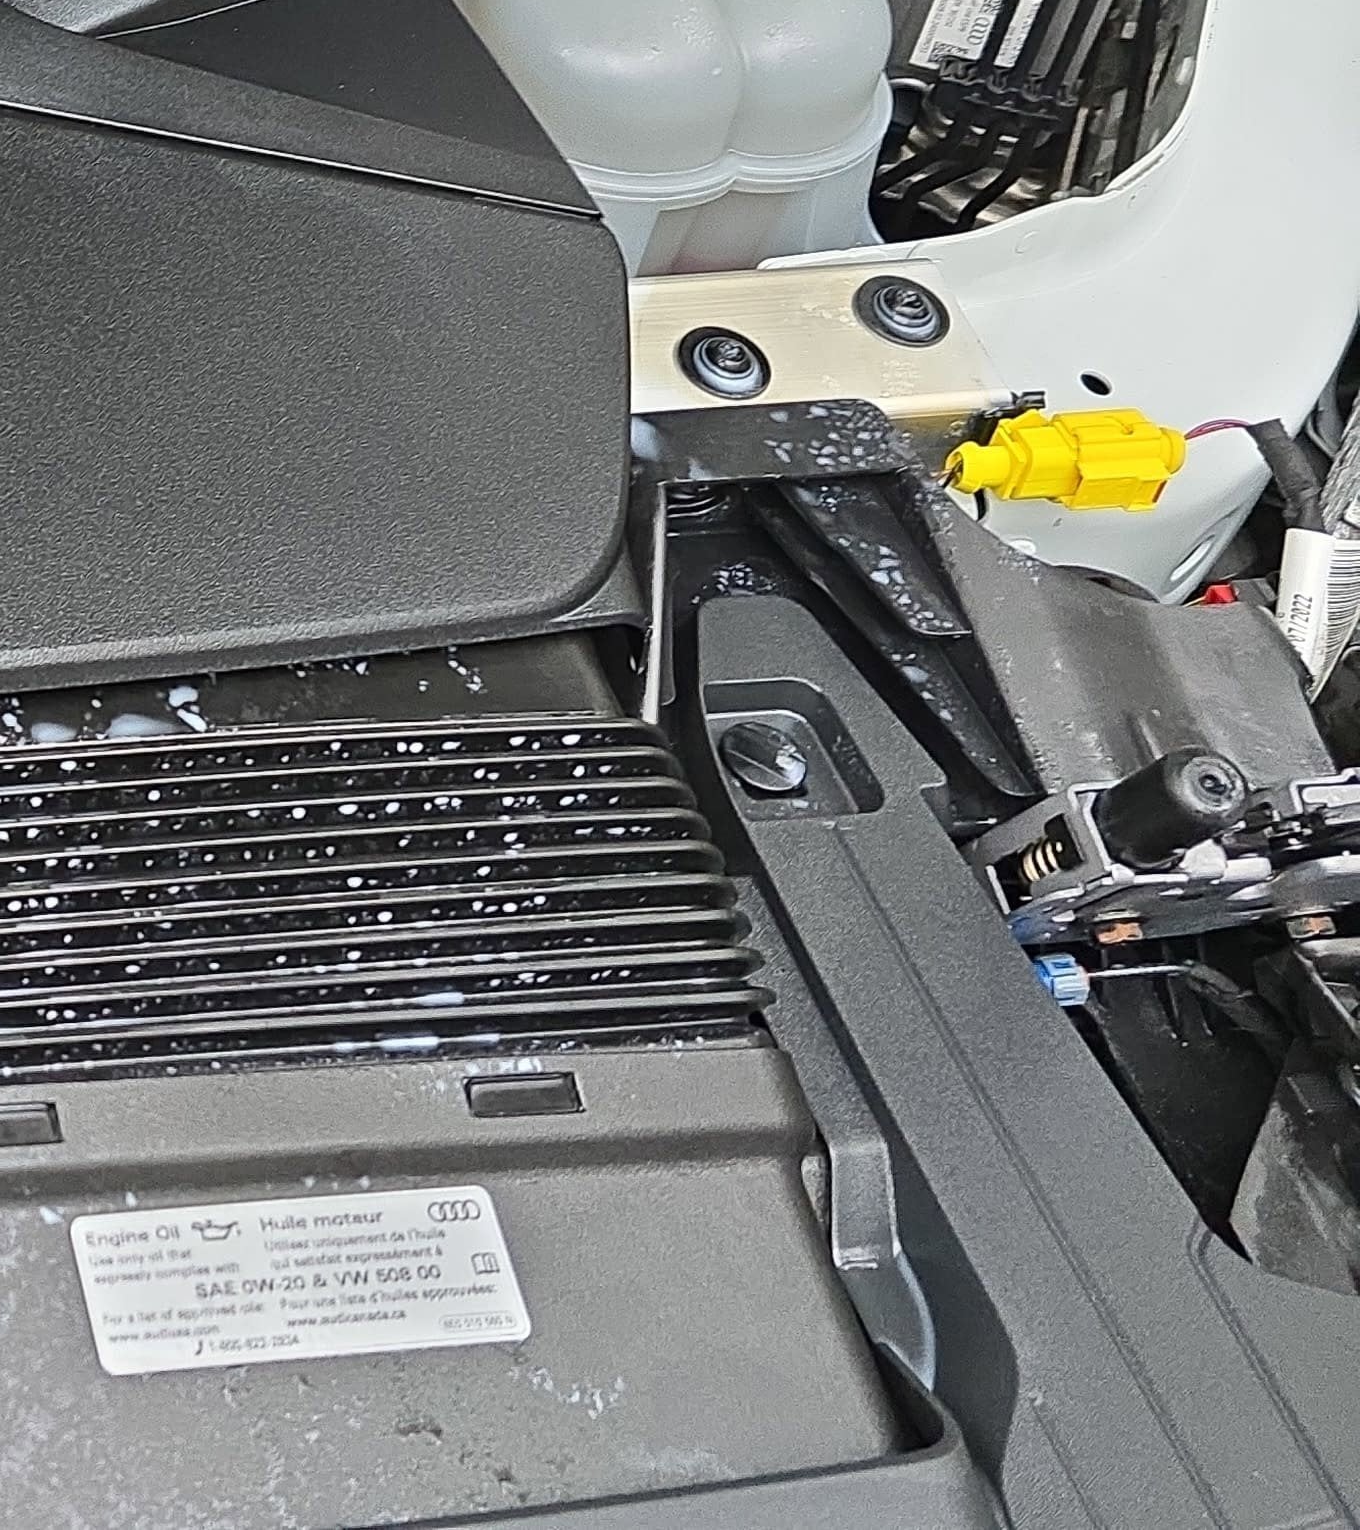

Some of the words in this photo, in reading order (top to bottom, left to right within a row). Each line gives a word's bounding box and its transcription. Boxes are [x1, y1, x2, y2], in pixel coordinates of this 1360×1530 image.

[259, 1214, 308, 1232] Huile
[313, 1211, 383, 1227] moteur
[84, 1230, 149, 1248] Engine
[156, 1225, 180, 1240] Oil
[312, 1232, 385, 1249] uniquement
[389, 1230, 405, 1242] de
[166, 1249, 192, 1260] that
[154, 1266, 211, 1282] complies
[216, 1261, 240, 1273] with
[195, 1281, 237, 1299] SAE
[241, 1276, 305, 1295] 0W-20
[313, 1274, 327, 1288] &
[333, 1270, 369, 1287] VW
[375, 1266, 412, 1283] 508
[417, 1264, 441, 1279] 00
